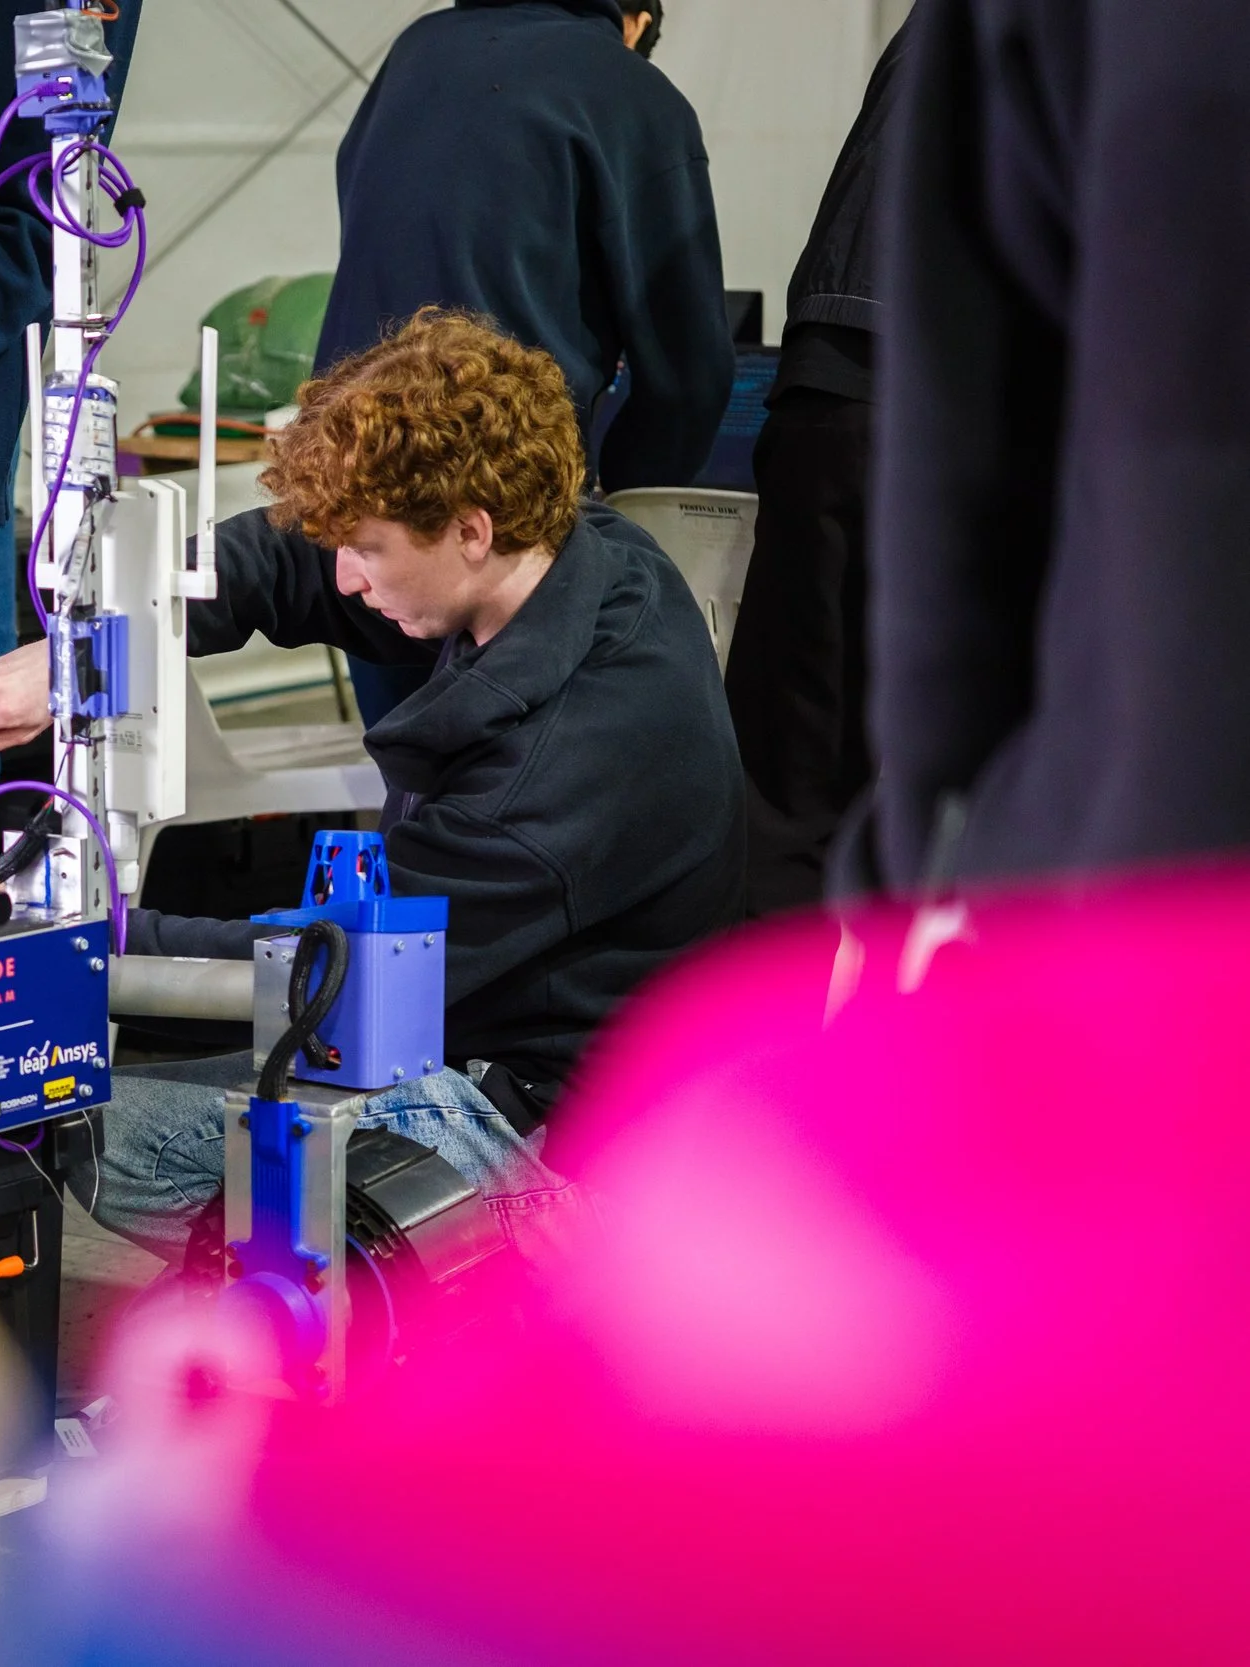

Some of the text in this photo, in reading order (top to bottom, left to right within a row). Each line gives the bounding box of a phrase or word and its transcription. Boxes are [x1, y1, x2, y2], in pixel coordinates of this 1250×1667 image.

[679, 503, 715, 512] FESTIVAL
[19, 1054, 49, 1076] leap
[50, 1041, 98, 1067] Ansys
